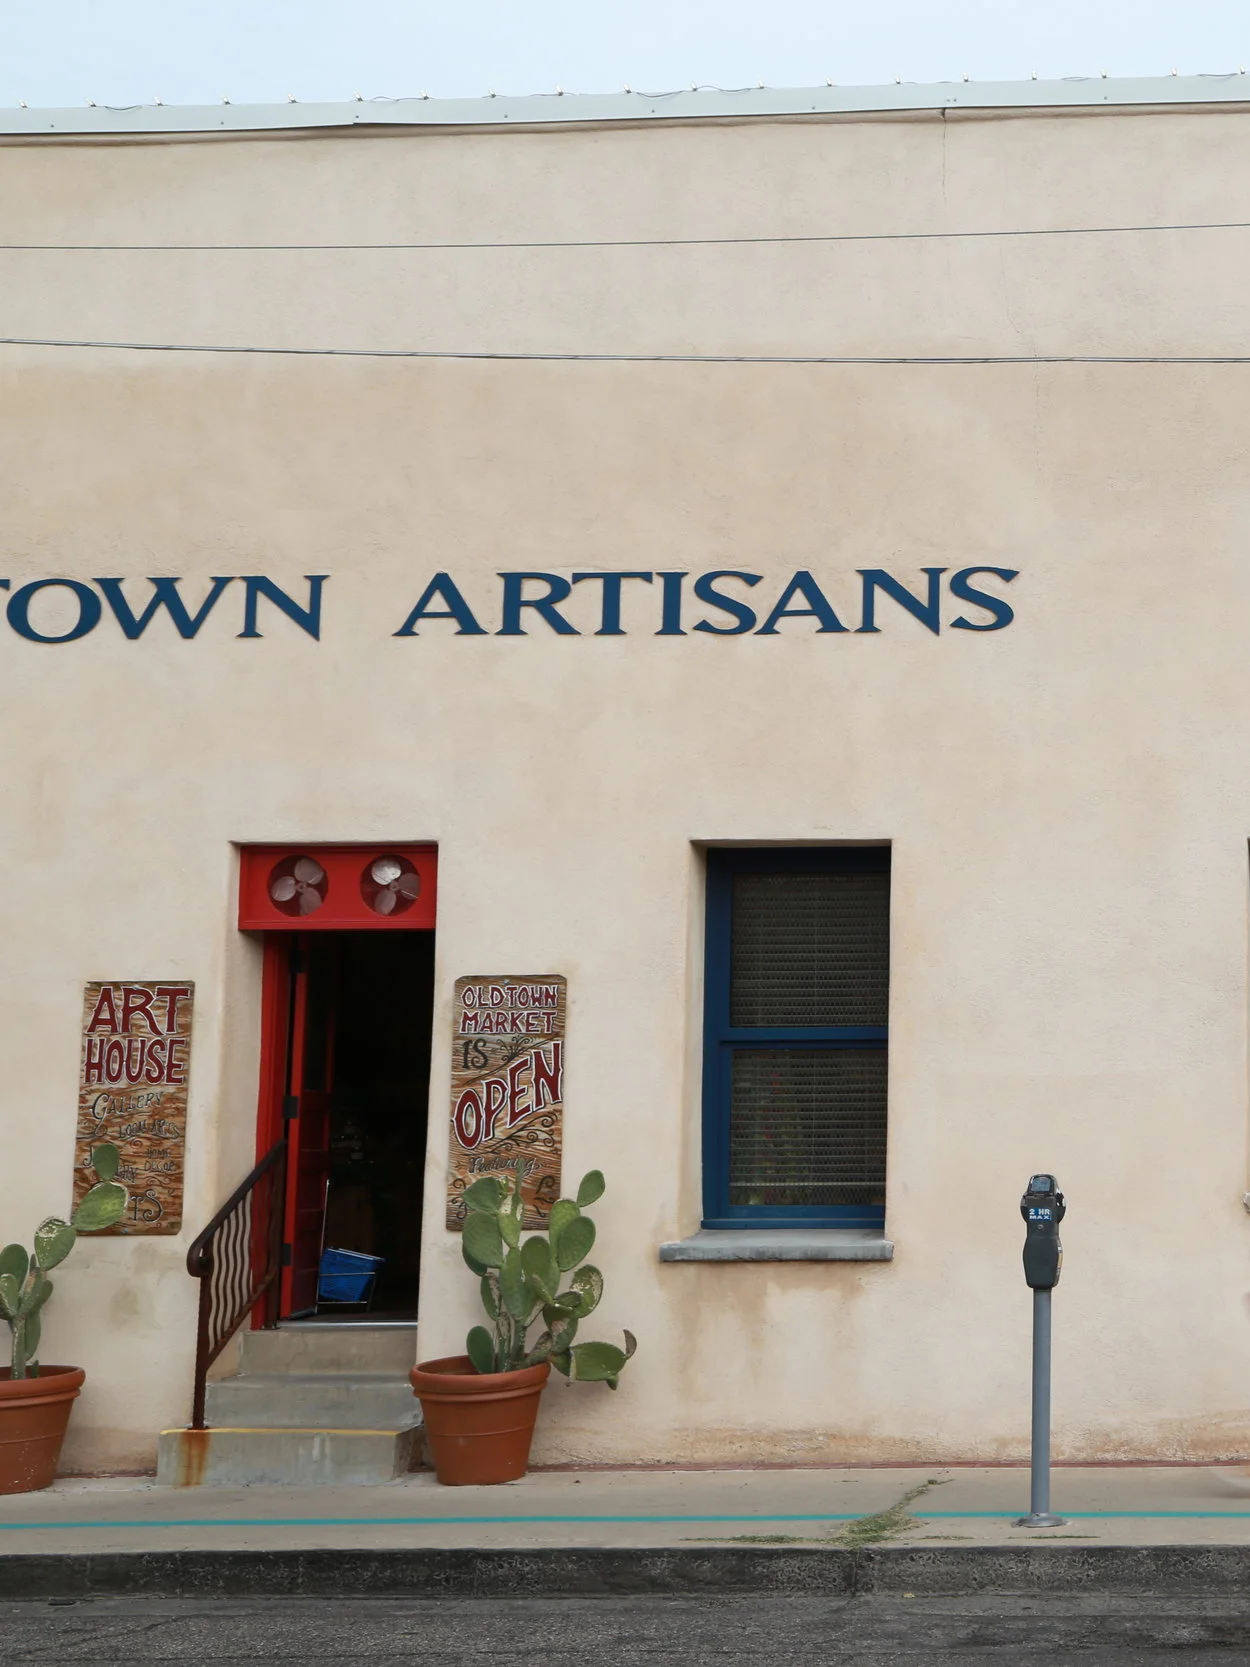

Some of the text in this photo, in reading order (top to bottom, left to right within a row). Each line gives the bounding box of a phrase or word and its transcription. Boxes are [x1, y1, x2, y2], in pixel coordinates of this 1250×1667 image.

[0, 566, 1020, 643] OWN ARTISANS
[86, 986, 191, 1036] ART
[461, 985, 559, 1008] OLDTOWN
[459, 1010, 558, 1034] MARKET
[84, 1038, 186, 1085] HOUSE
[461, 1038, 489, 1070] IS
[453, 1041, 564, 1149] OPEN
